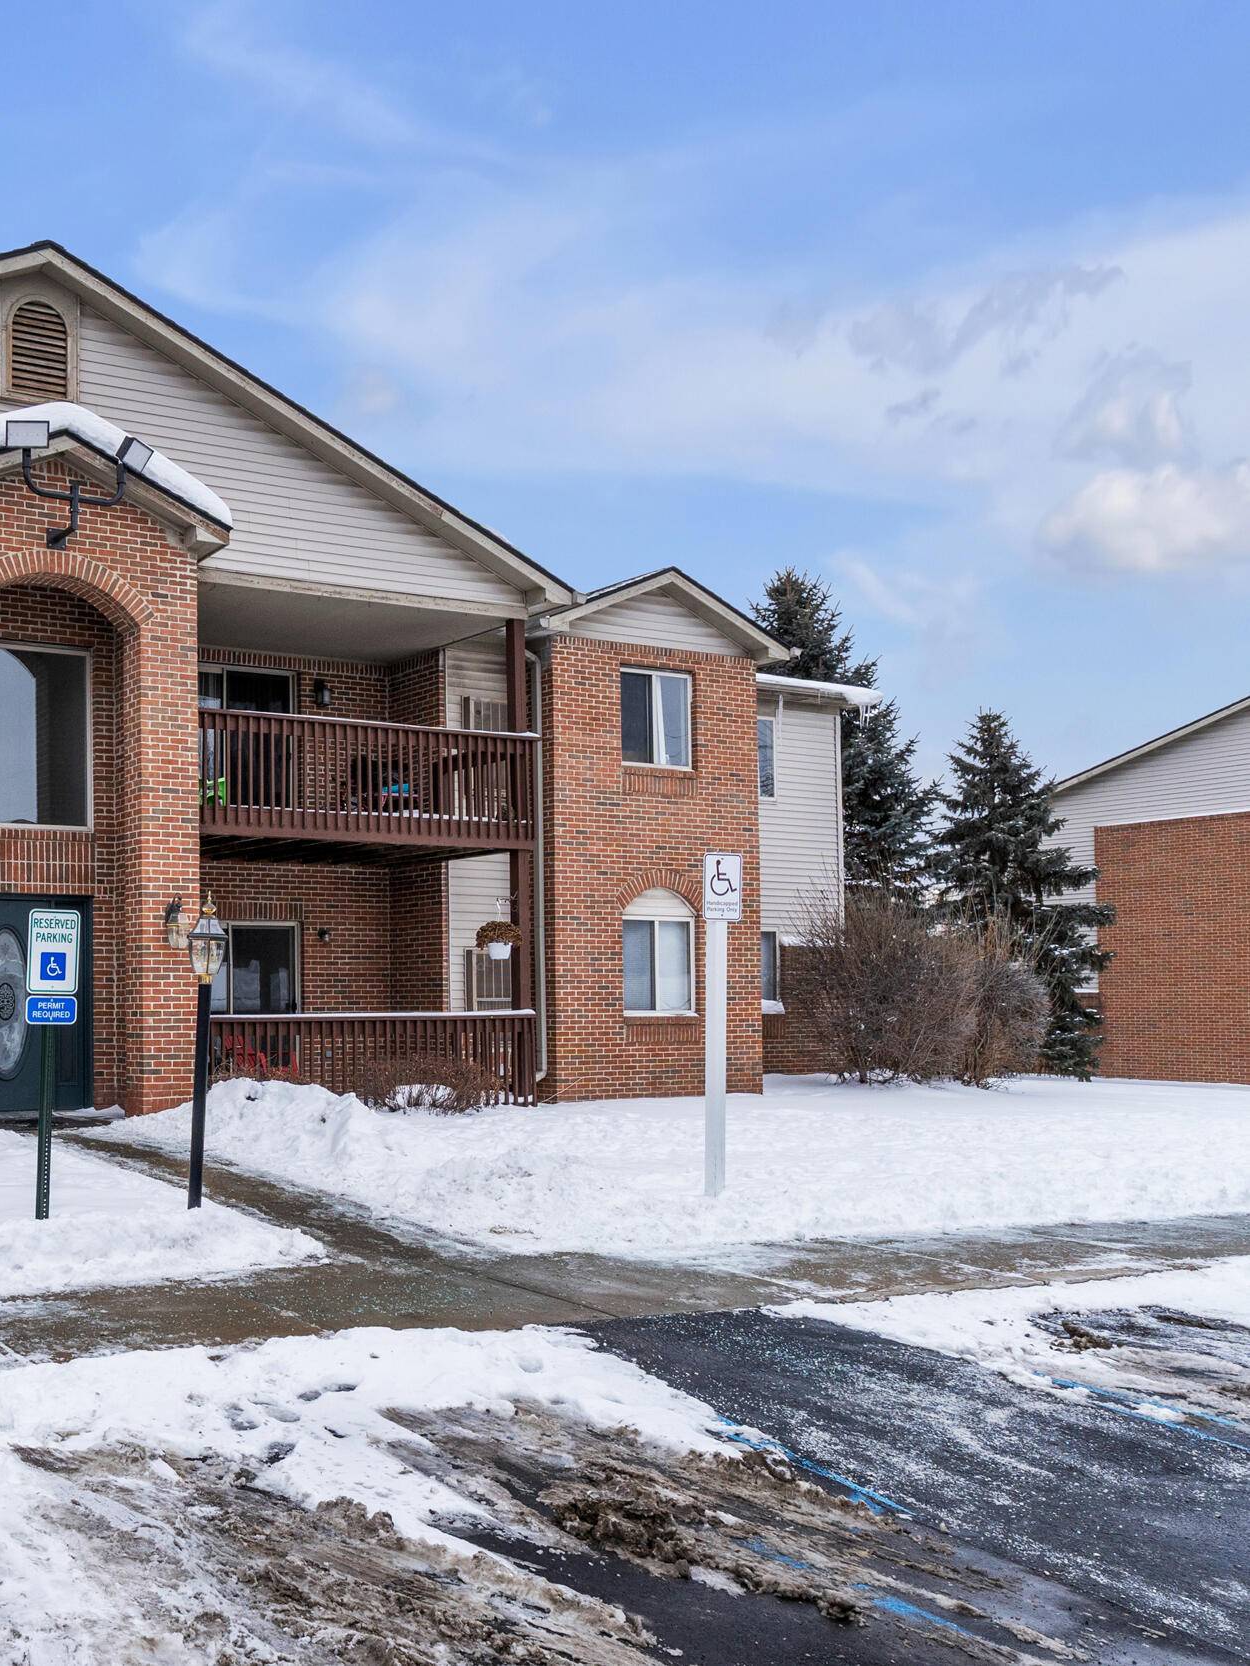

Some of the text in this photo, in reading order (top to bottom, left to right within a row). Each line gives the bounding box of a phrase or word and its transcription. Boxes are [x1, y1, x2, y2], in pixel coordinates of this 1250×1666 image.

[33, 917, 76, 930] RESERVED
[35, 932, 73, 943] PARKING
[37, 1002, 65, 1010] PERMIT
[32, 1010, 71, 1019] REQUIRED
